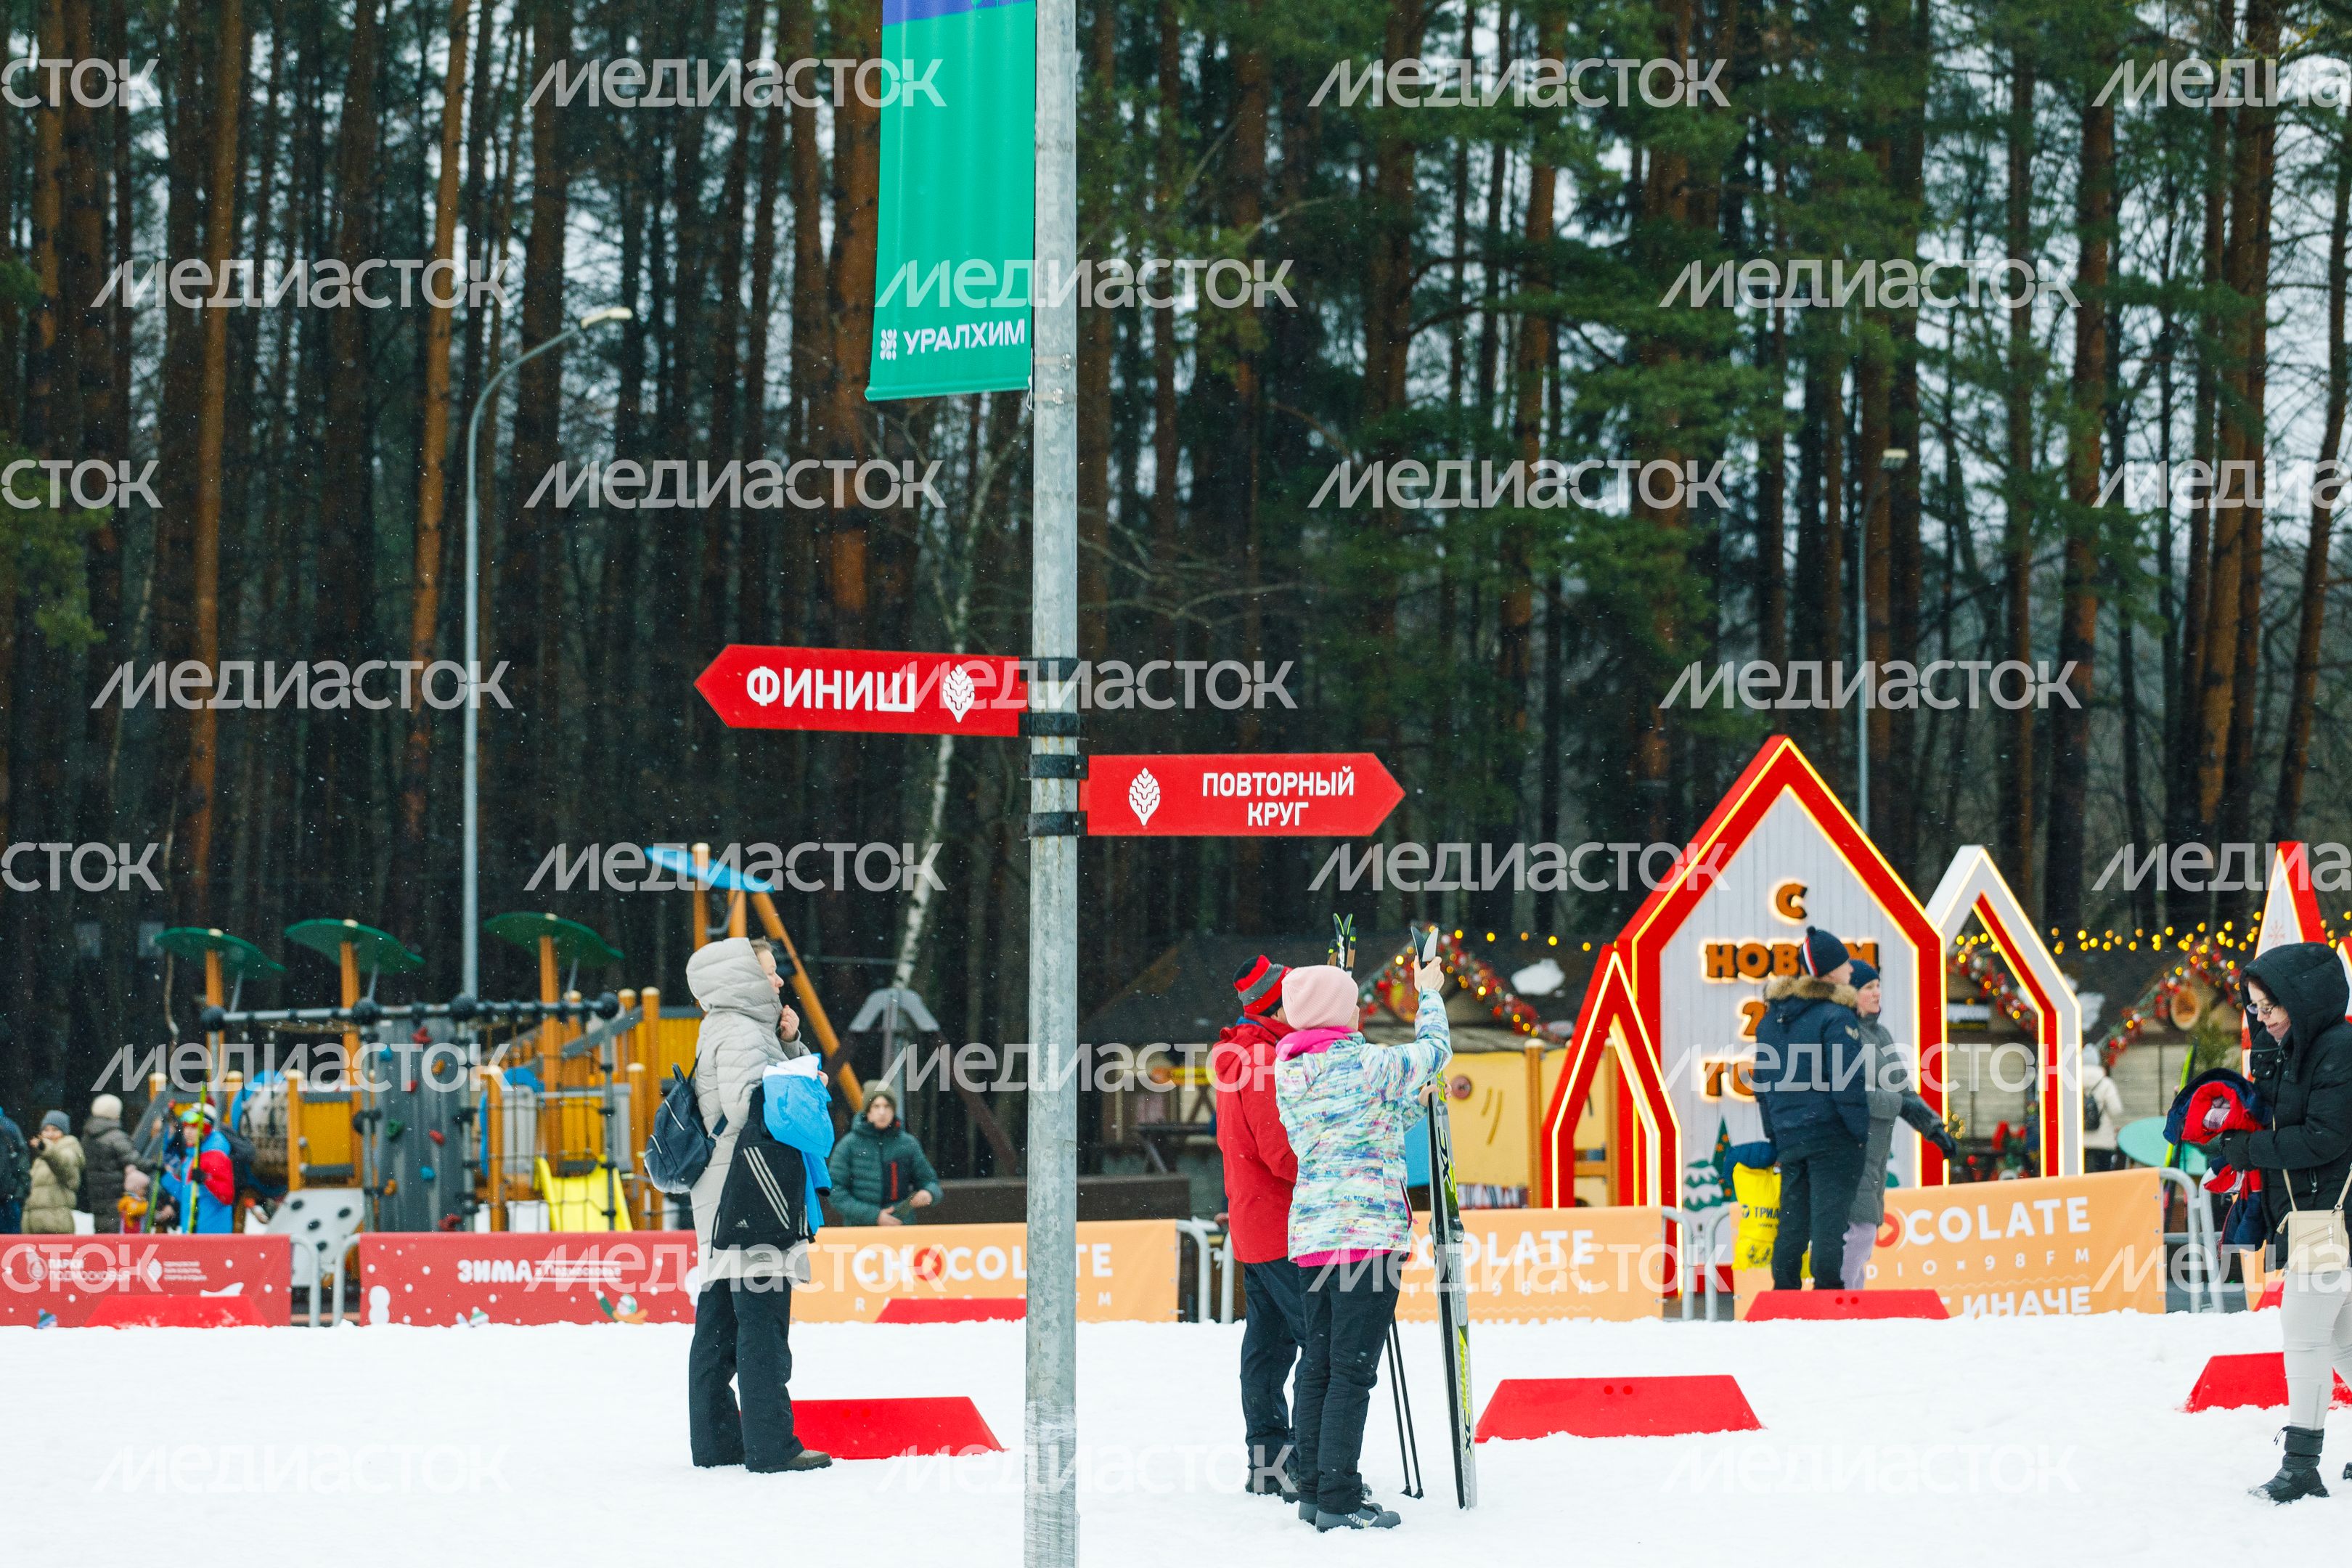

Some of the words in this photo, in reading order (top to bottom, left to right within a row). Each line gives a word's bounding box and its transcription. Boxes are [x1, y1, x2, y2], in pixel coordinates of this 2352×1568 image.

[902, 319, 1025, 355] УРАЛХИМ
[746, 666, 915, 713] ФИНИШ
[1202, 766, 1355, 797] ПОВТОРНЫЙ
[1247, 802, 1309, 827] КРУГ
[1776, 883, 1808, 920] С
[1704, 943, 1879, 979] НОВМ
[1874, 1196, 2091, 1247] OCOLATE
[852, 1243, 1113, 1283] CHOCOLE
[1416, 1230, 1595, 1269] COLATE
[457, 1259, 533, 1283] ЗИМА
[1962, 1285, 2091, 1318] ИНАЧЕ
